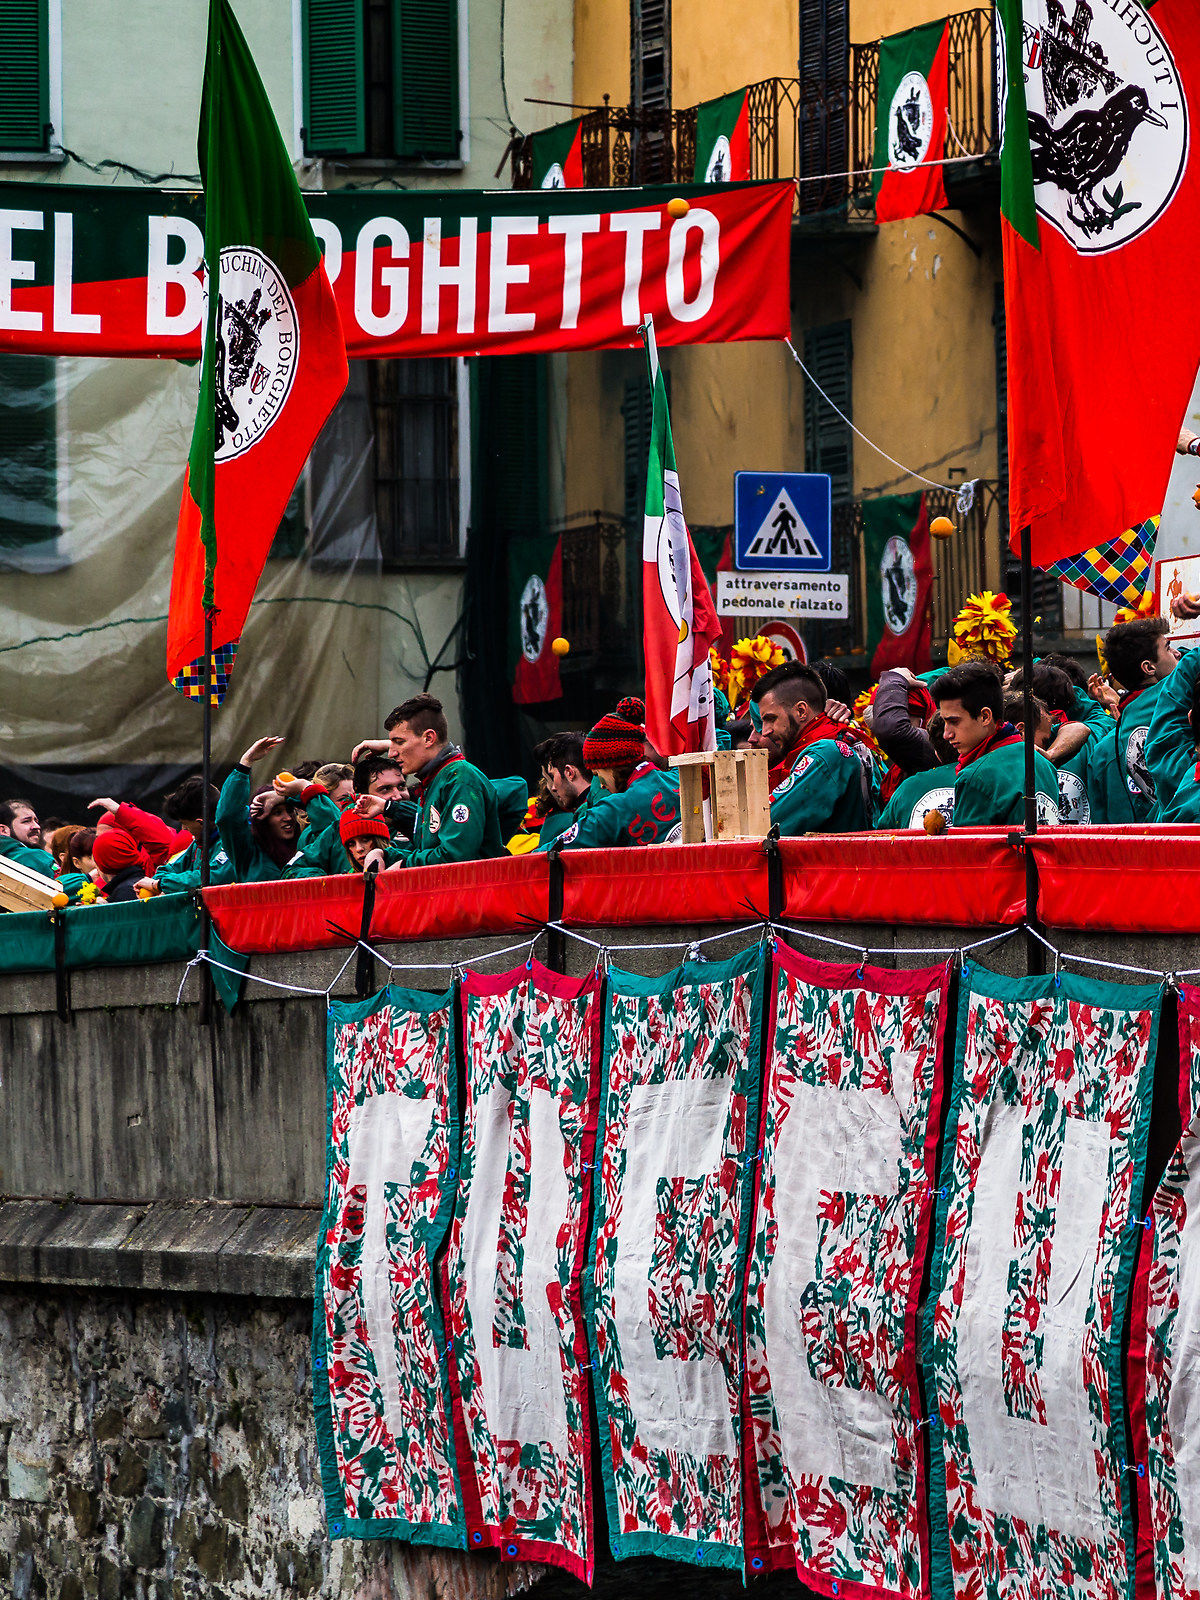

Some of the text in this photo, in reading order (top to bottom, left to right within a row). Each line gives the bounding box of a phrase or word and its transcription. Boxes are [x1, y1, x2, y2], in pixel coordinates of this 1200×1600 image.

[146, 208, 720, 338] BGHETTO
[219, 255, 292, 449] UCHINI DEL BORGHETTO
[722, 597, 843, 612] pedonale rialzato
[726, 578, 841, 592] attraversamento
